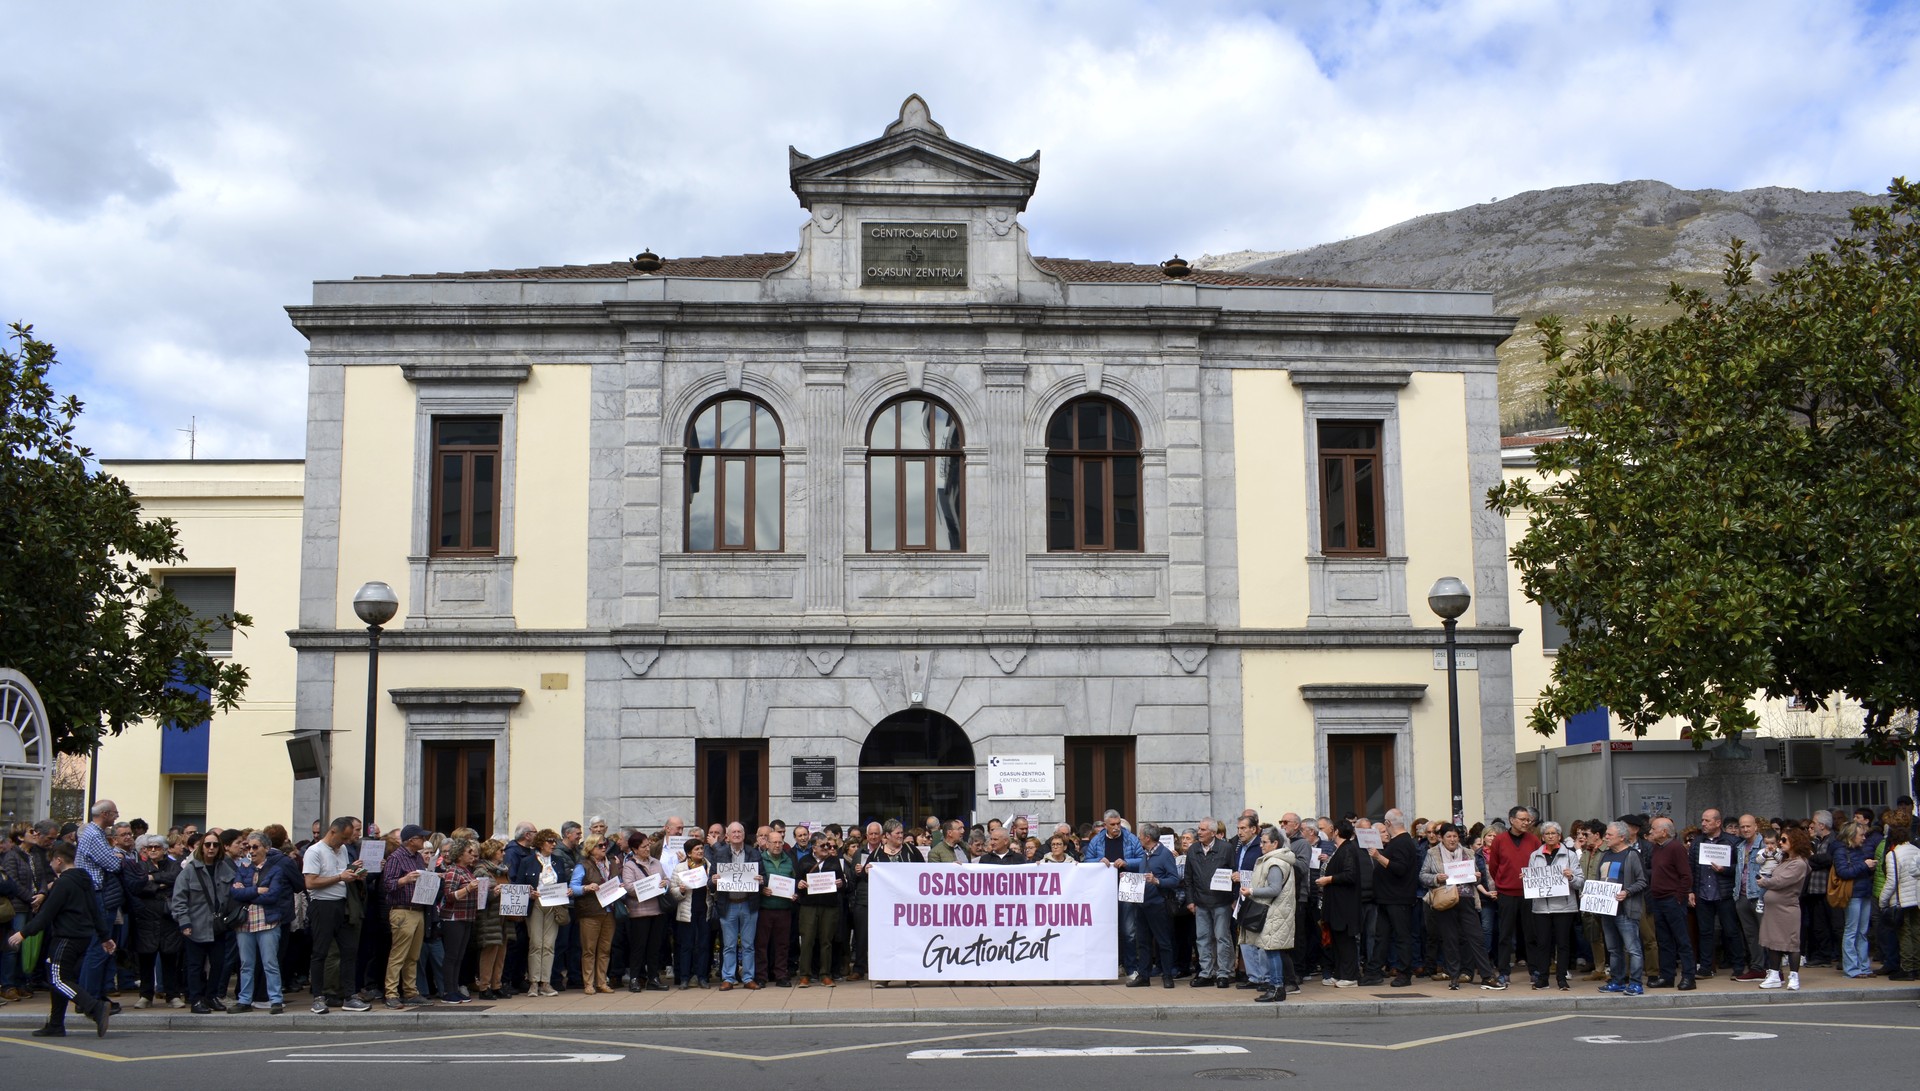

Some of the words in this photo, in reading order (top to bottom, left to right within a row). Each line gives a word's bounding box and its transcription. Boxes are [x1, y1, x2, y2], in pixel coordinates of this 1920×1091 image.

[872, 228, 915, 238] CENTRO
[923, 228, 957, 238] SALUD
[868, 267, 910, 277] OSASUN
[916, 267, 963, 277] ZENTRUA
[719, 863, 756, 872] OSASUNA
[732, 873, 743, 882] EZ
[918, 872, 1062, 896] OSASUNGINTZA
[1539, 887, 1553, 897] EZ
[510, 895, 520, 904] EZ
[893, 903, 988, 927] PUBLIKOA
[994, 903, 1028, 927] ETA
[1034, 903, 1093, 927] DUINA
[922, 928, 1061, 974] Guztiontzat
